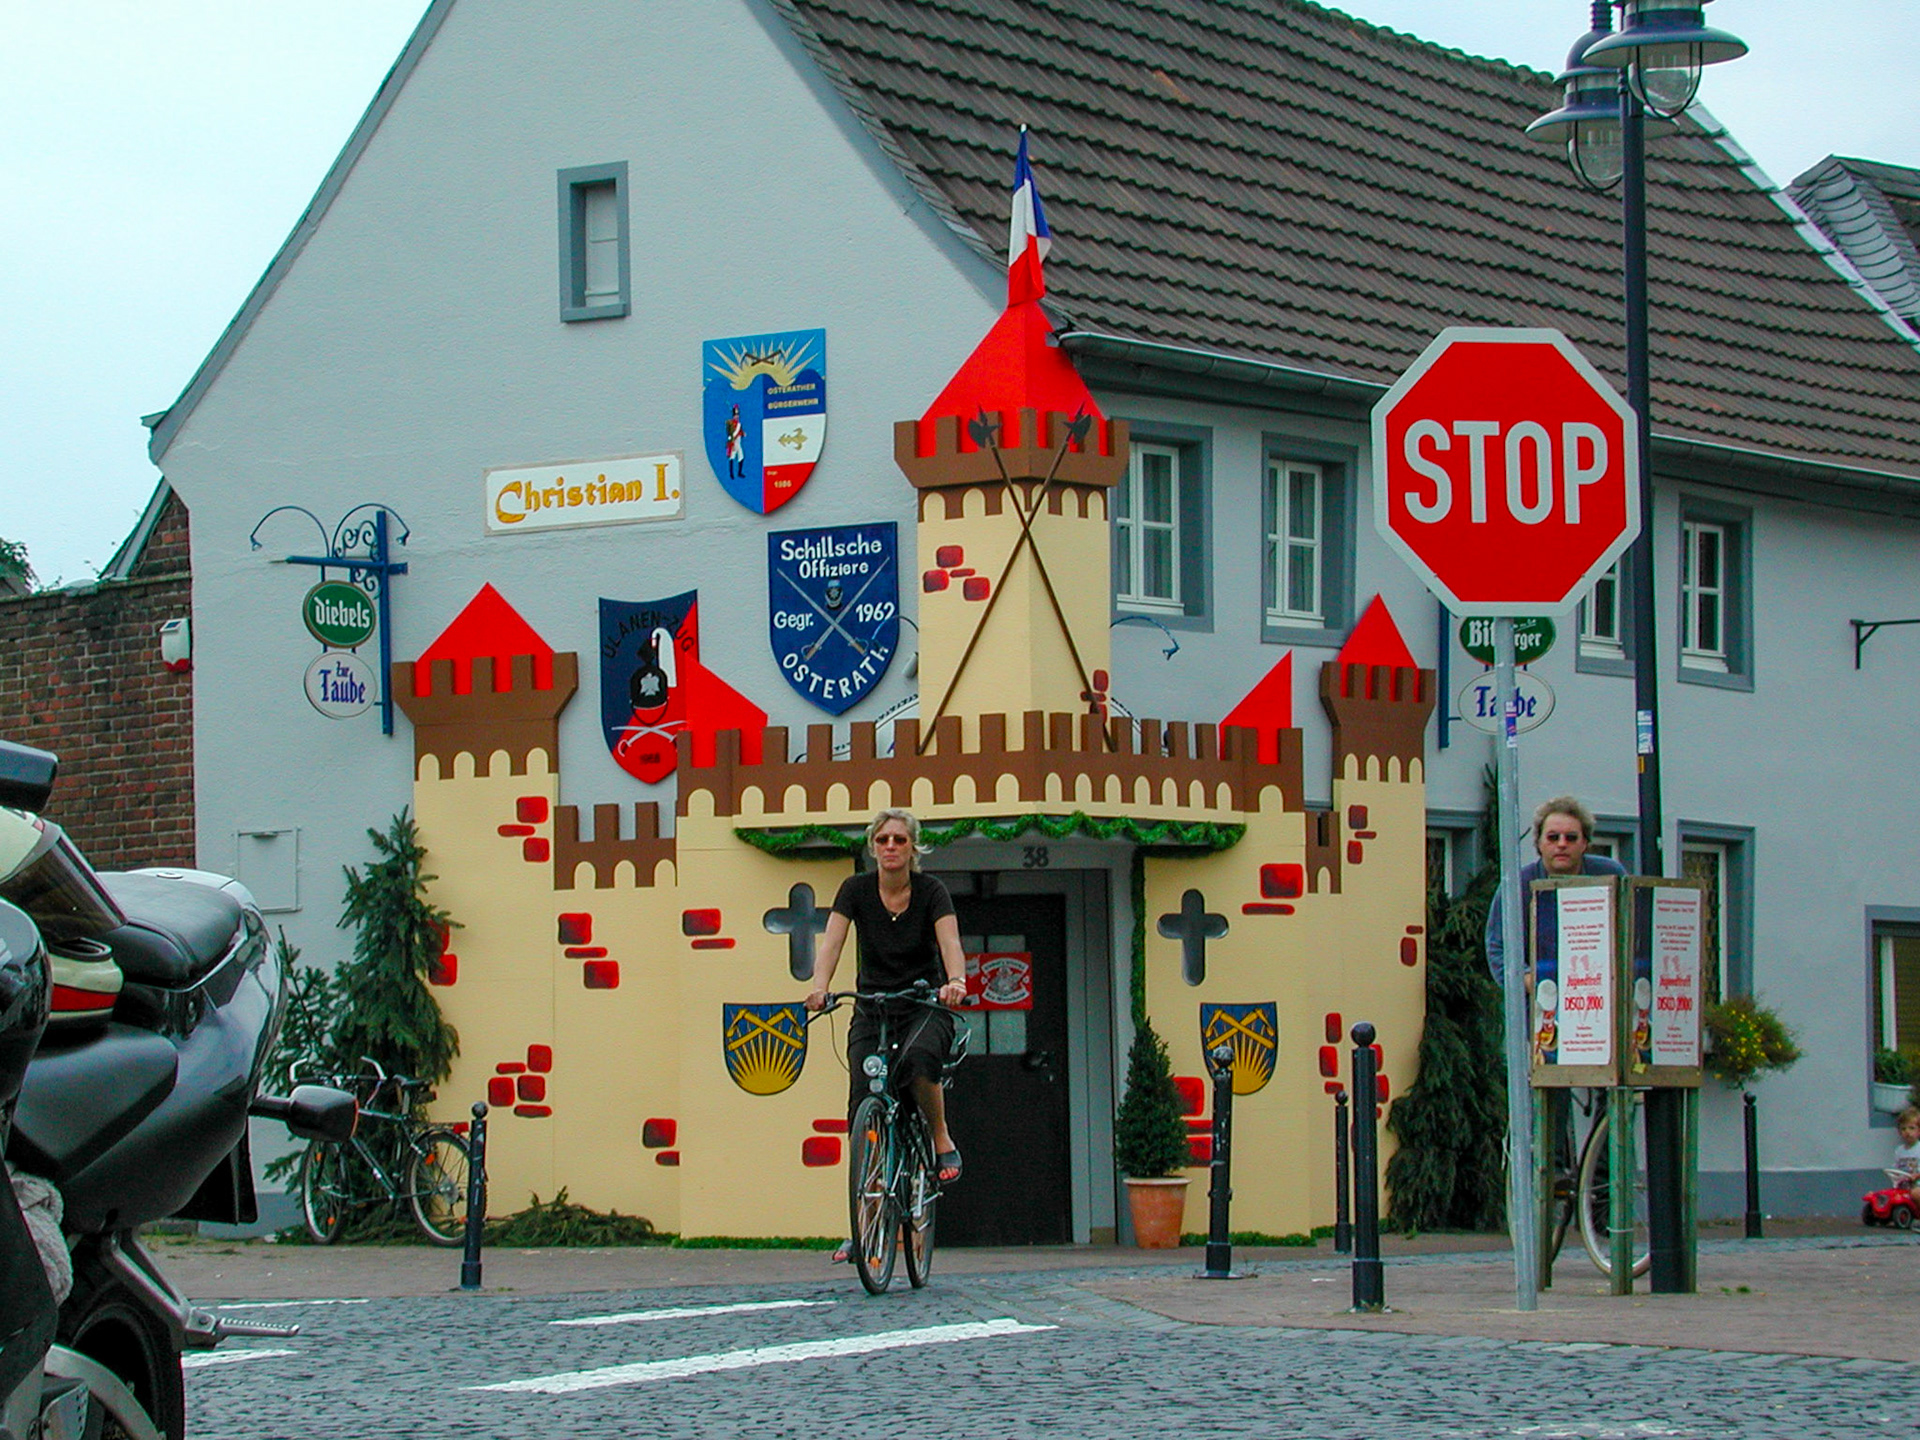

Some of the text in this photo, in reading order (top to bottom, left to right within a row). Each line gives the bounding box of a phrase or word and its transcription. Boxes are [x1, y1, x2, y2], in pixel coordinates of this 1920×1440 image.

[1404, 419, 1608, 525] STOP
[496, 463, 680, 524] Christian I.
[781, 533, 882, 561] Schillsche
[799, 558, 869, 579] Offiziere
[773, 610, 814, 631] Gegr.
[783, 646, 889, 699] OSTERATH
[319, 669, 365, 703] Taube
[1022, 846, 1049, 869] 38
[1565, 995, 1604, 1011] DISCO 2000
[1656, 995, 1693, 1011] DISCO 2000
